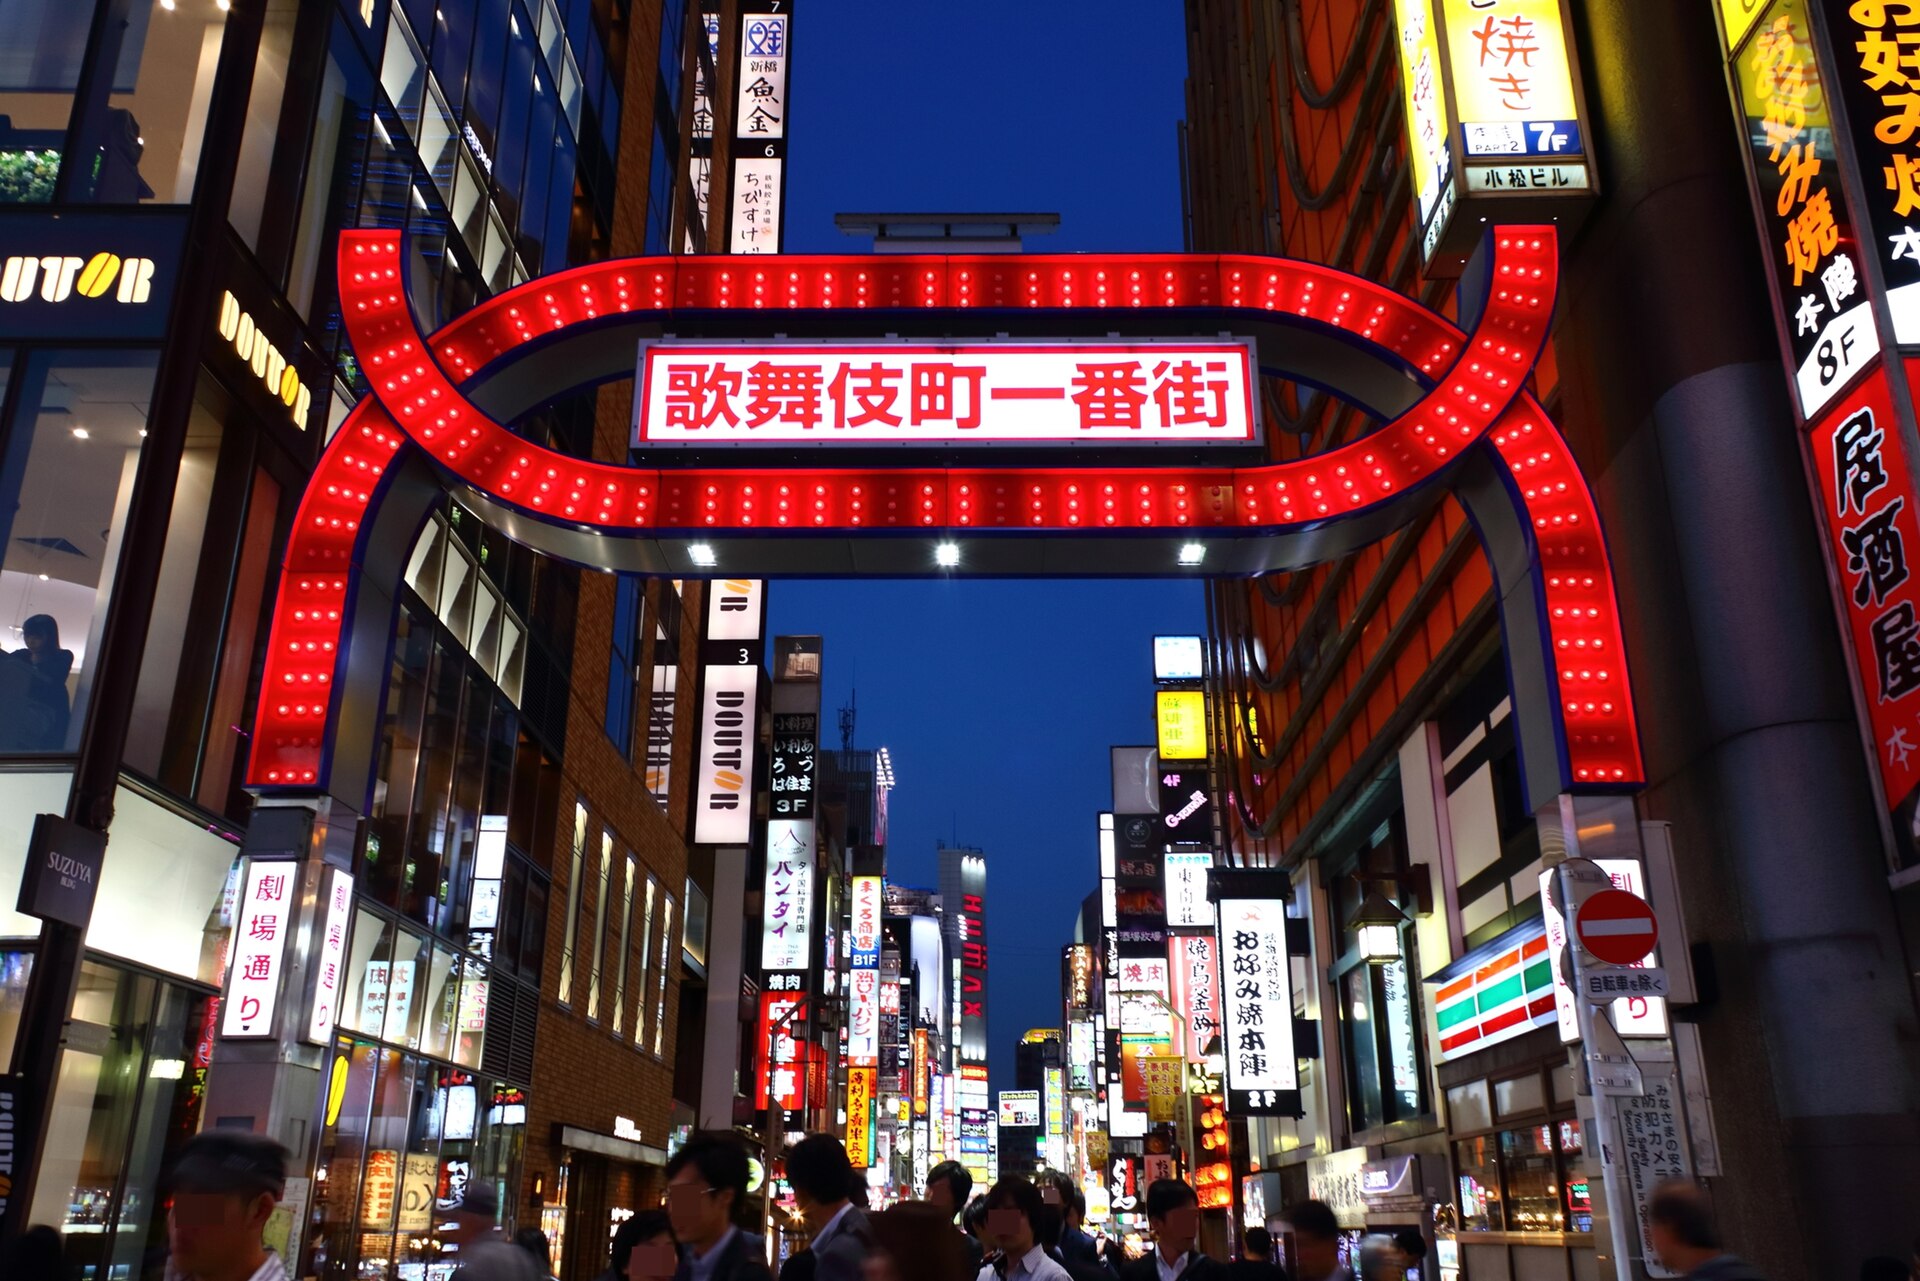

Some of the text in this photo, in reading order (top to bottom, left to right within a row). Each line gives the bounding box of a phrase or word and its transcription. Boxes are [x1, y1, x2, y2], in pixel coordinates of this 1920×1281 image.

[770, 1, 780, 13] 7
[750, 60, 778, 73] 新橋
[1471, 0, 1540, 110] 焼き
[744, 76, 780, 134] 魚金
[764, 144, 775, 157] 6
[1529, 122, 1568, 152] 7F
[1485, 168, 1569, 188] 小松ビル
[741, 172, 763, 254] ちびすけ
[0, 252, 155, 303] UTOR
[1794, 253, 1857, 337] 本陣
[218, 289, 312, 432] DOUTOR
[1817, 324, 1855, 387] 8F
[665, 360, 1230, 430] 歌舞伎町一番街
[1831, 405, 1920, 704] 居酒屋
[738, 648, 749, 664] 3
[709, 691, 745, 811] DOUTOR
[1163, 774, 1181, 788] 4F
[776, 799, 808, 813] 3F
[47, 851, 92, 884] SUZUYA
[240, 874, 285, 1021] 劇場通り
[853, 954, 877, 966] B1F
[768, 974, 800, 990] 焼肉
[1589, 974, 1664, 994] 自転車を除く
[1248, 1090, 1277, 1108] 2F
[1631, 1152, 1644, 1190] Camera
